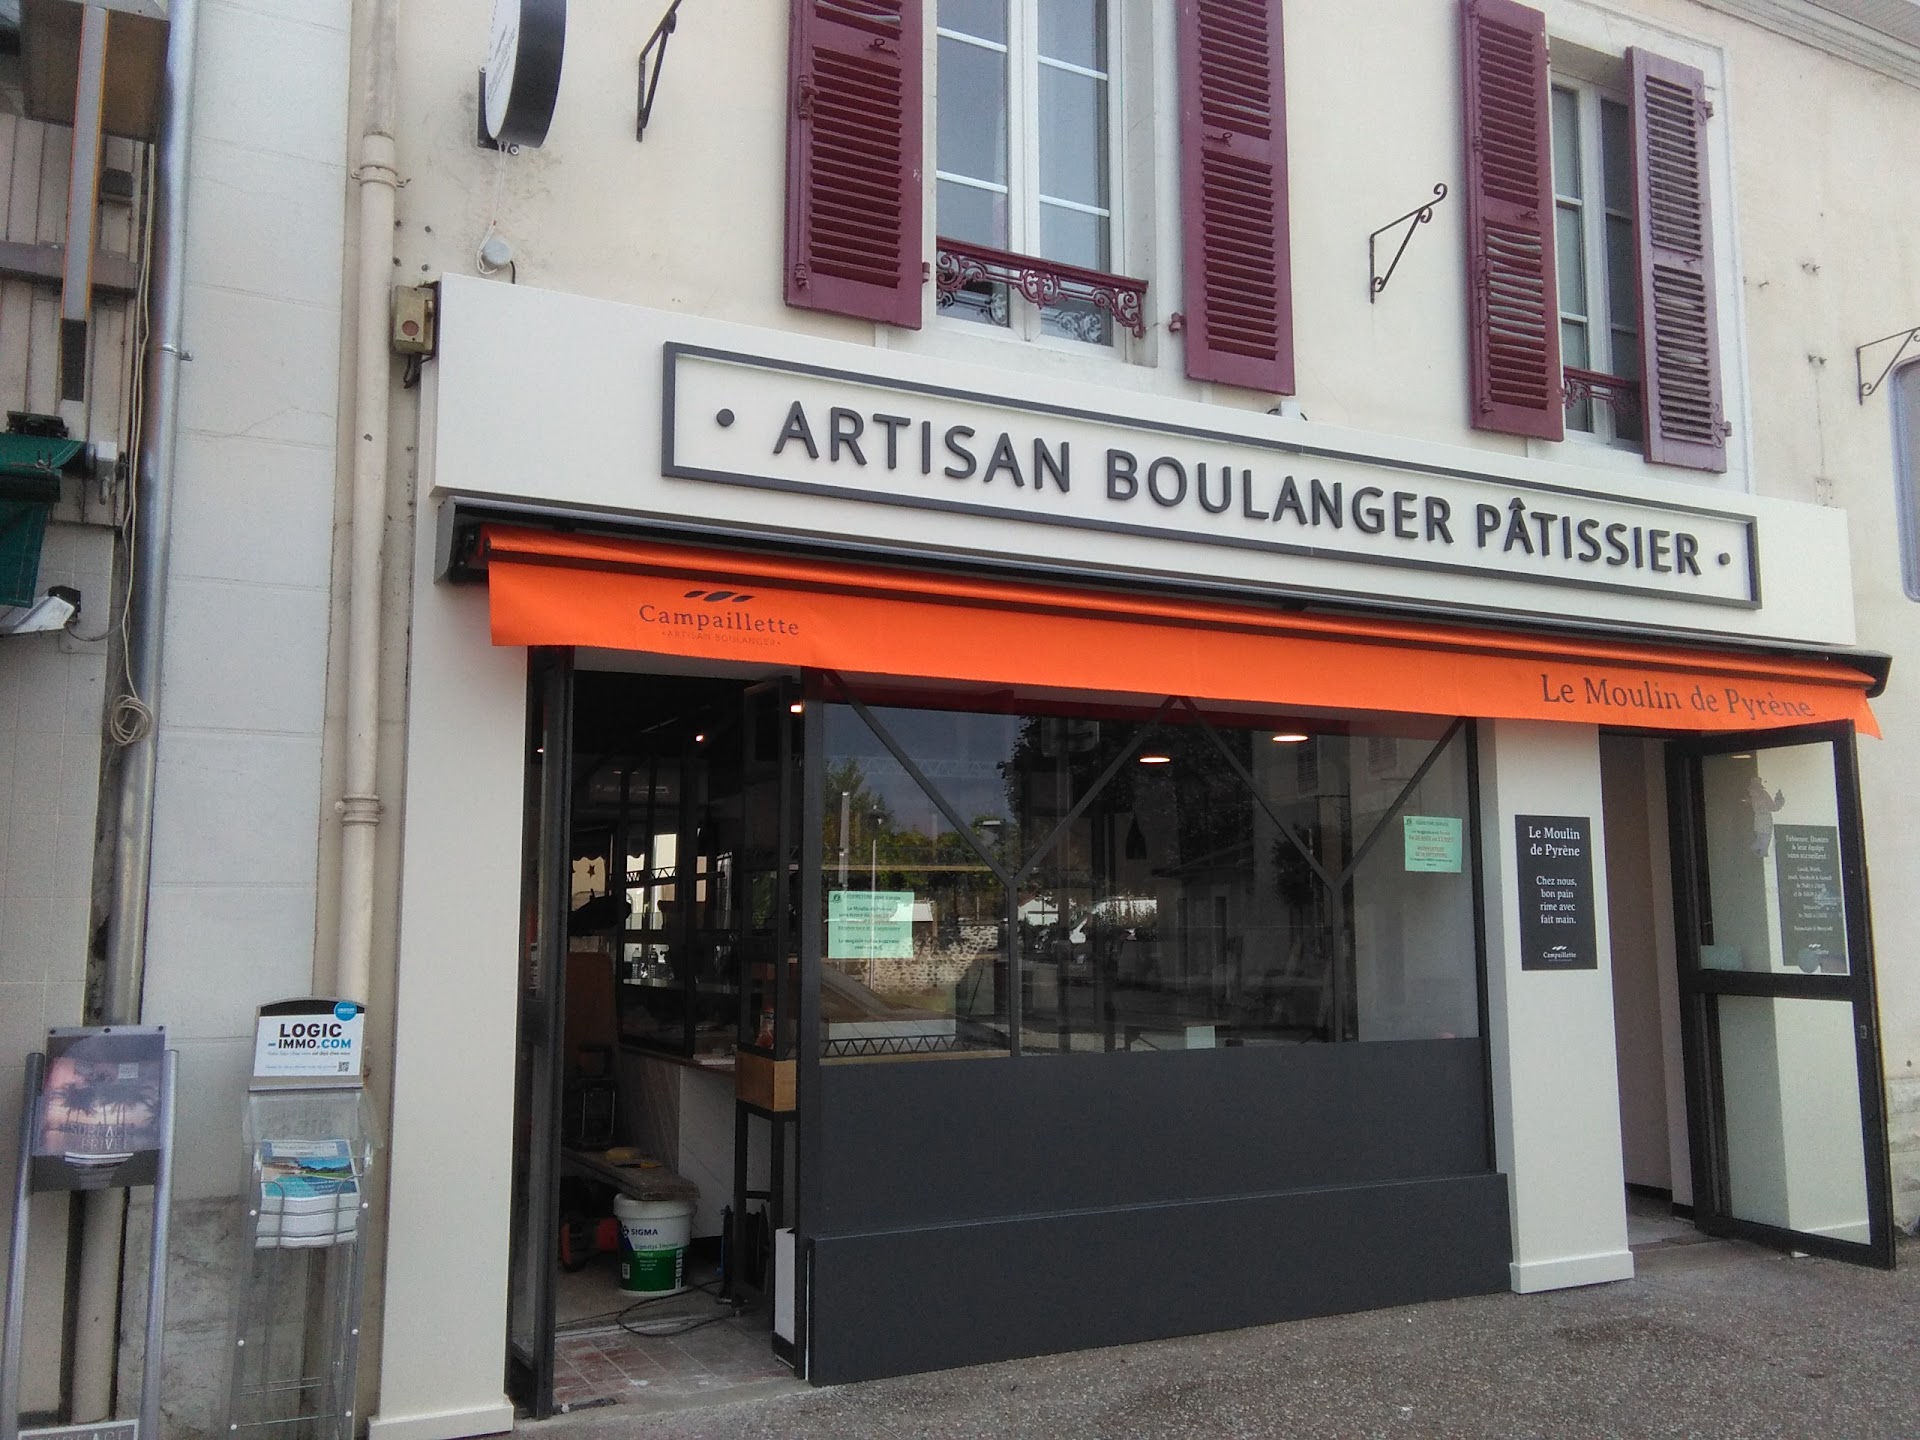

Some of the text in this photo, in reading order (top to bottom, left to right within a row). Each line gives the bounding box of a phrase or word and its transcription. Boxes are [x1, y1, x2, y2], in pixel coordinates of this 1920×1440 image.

[773, 400, 1702, 576] ARTISAN BOULANGER PÂTISSIER
[639, 605, 799, 635] Campaillette
[1541, 674, 1816, 720] Le Moulin de Pyrène
[1528, 826, 1580, 840] Le Moulin
[1530, 843, 1581, 859] de Pyrène
[1535, 876, 1577, 887] Chez nous,
[1541, 889, 1574, 900] bon pain
[1540, 902, 1576, 911] rime avec
[1540, 914, 1577, 924] fait main.
[279, 1023, 342, 1038] LOGIC
